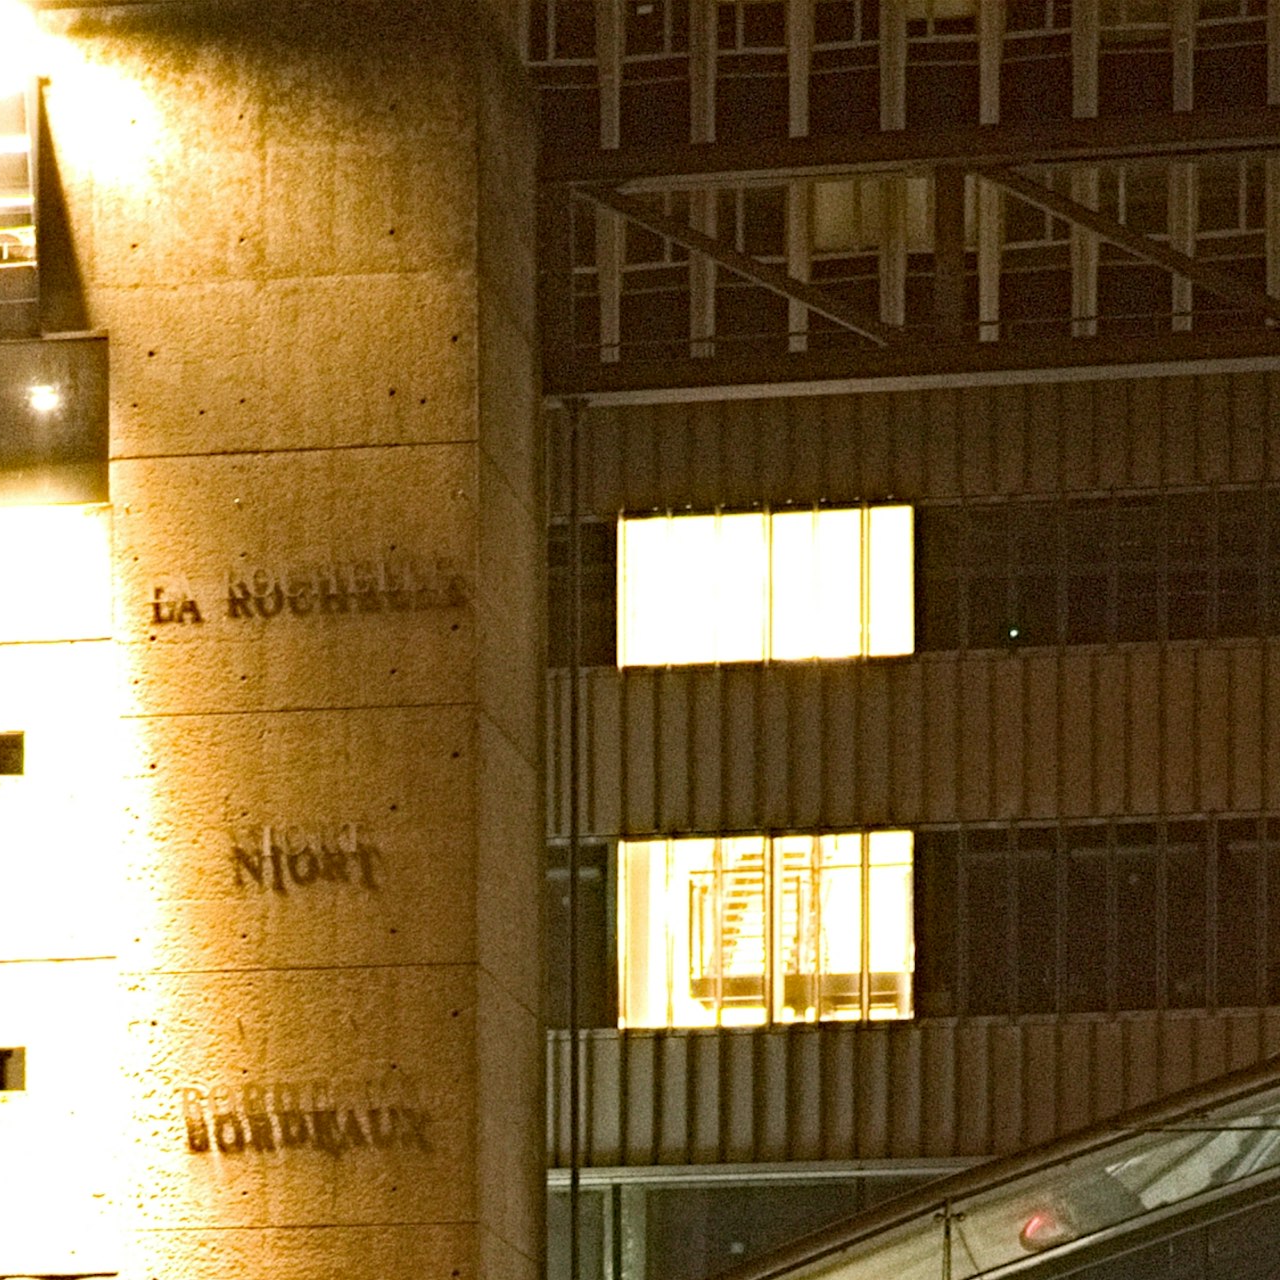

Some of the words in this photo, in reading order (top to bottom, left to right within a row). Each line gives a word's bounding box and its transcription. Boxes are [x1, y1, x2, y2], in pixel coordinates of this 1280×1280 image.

[148, 574, 204, 623] LA
[225, 558, 470, 620] ROCHELLE
[231, 823, 382, 894] NIORT
[180, 1081, 436, 1155] BORDEAUX
